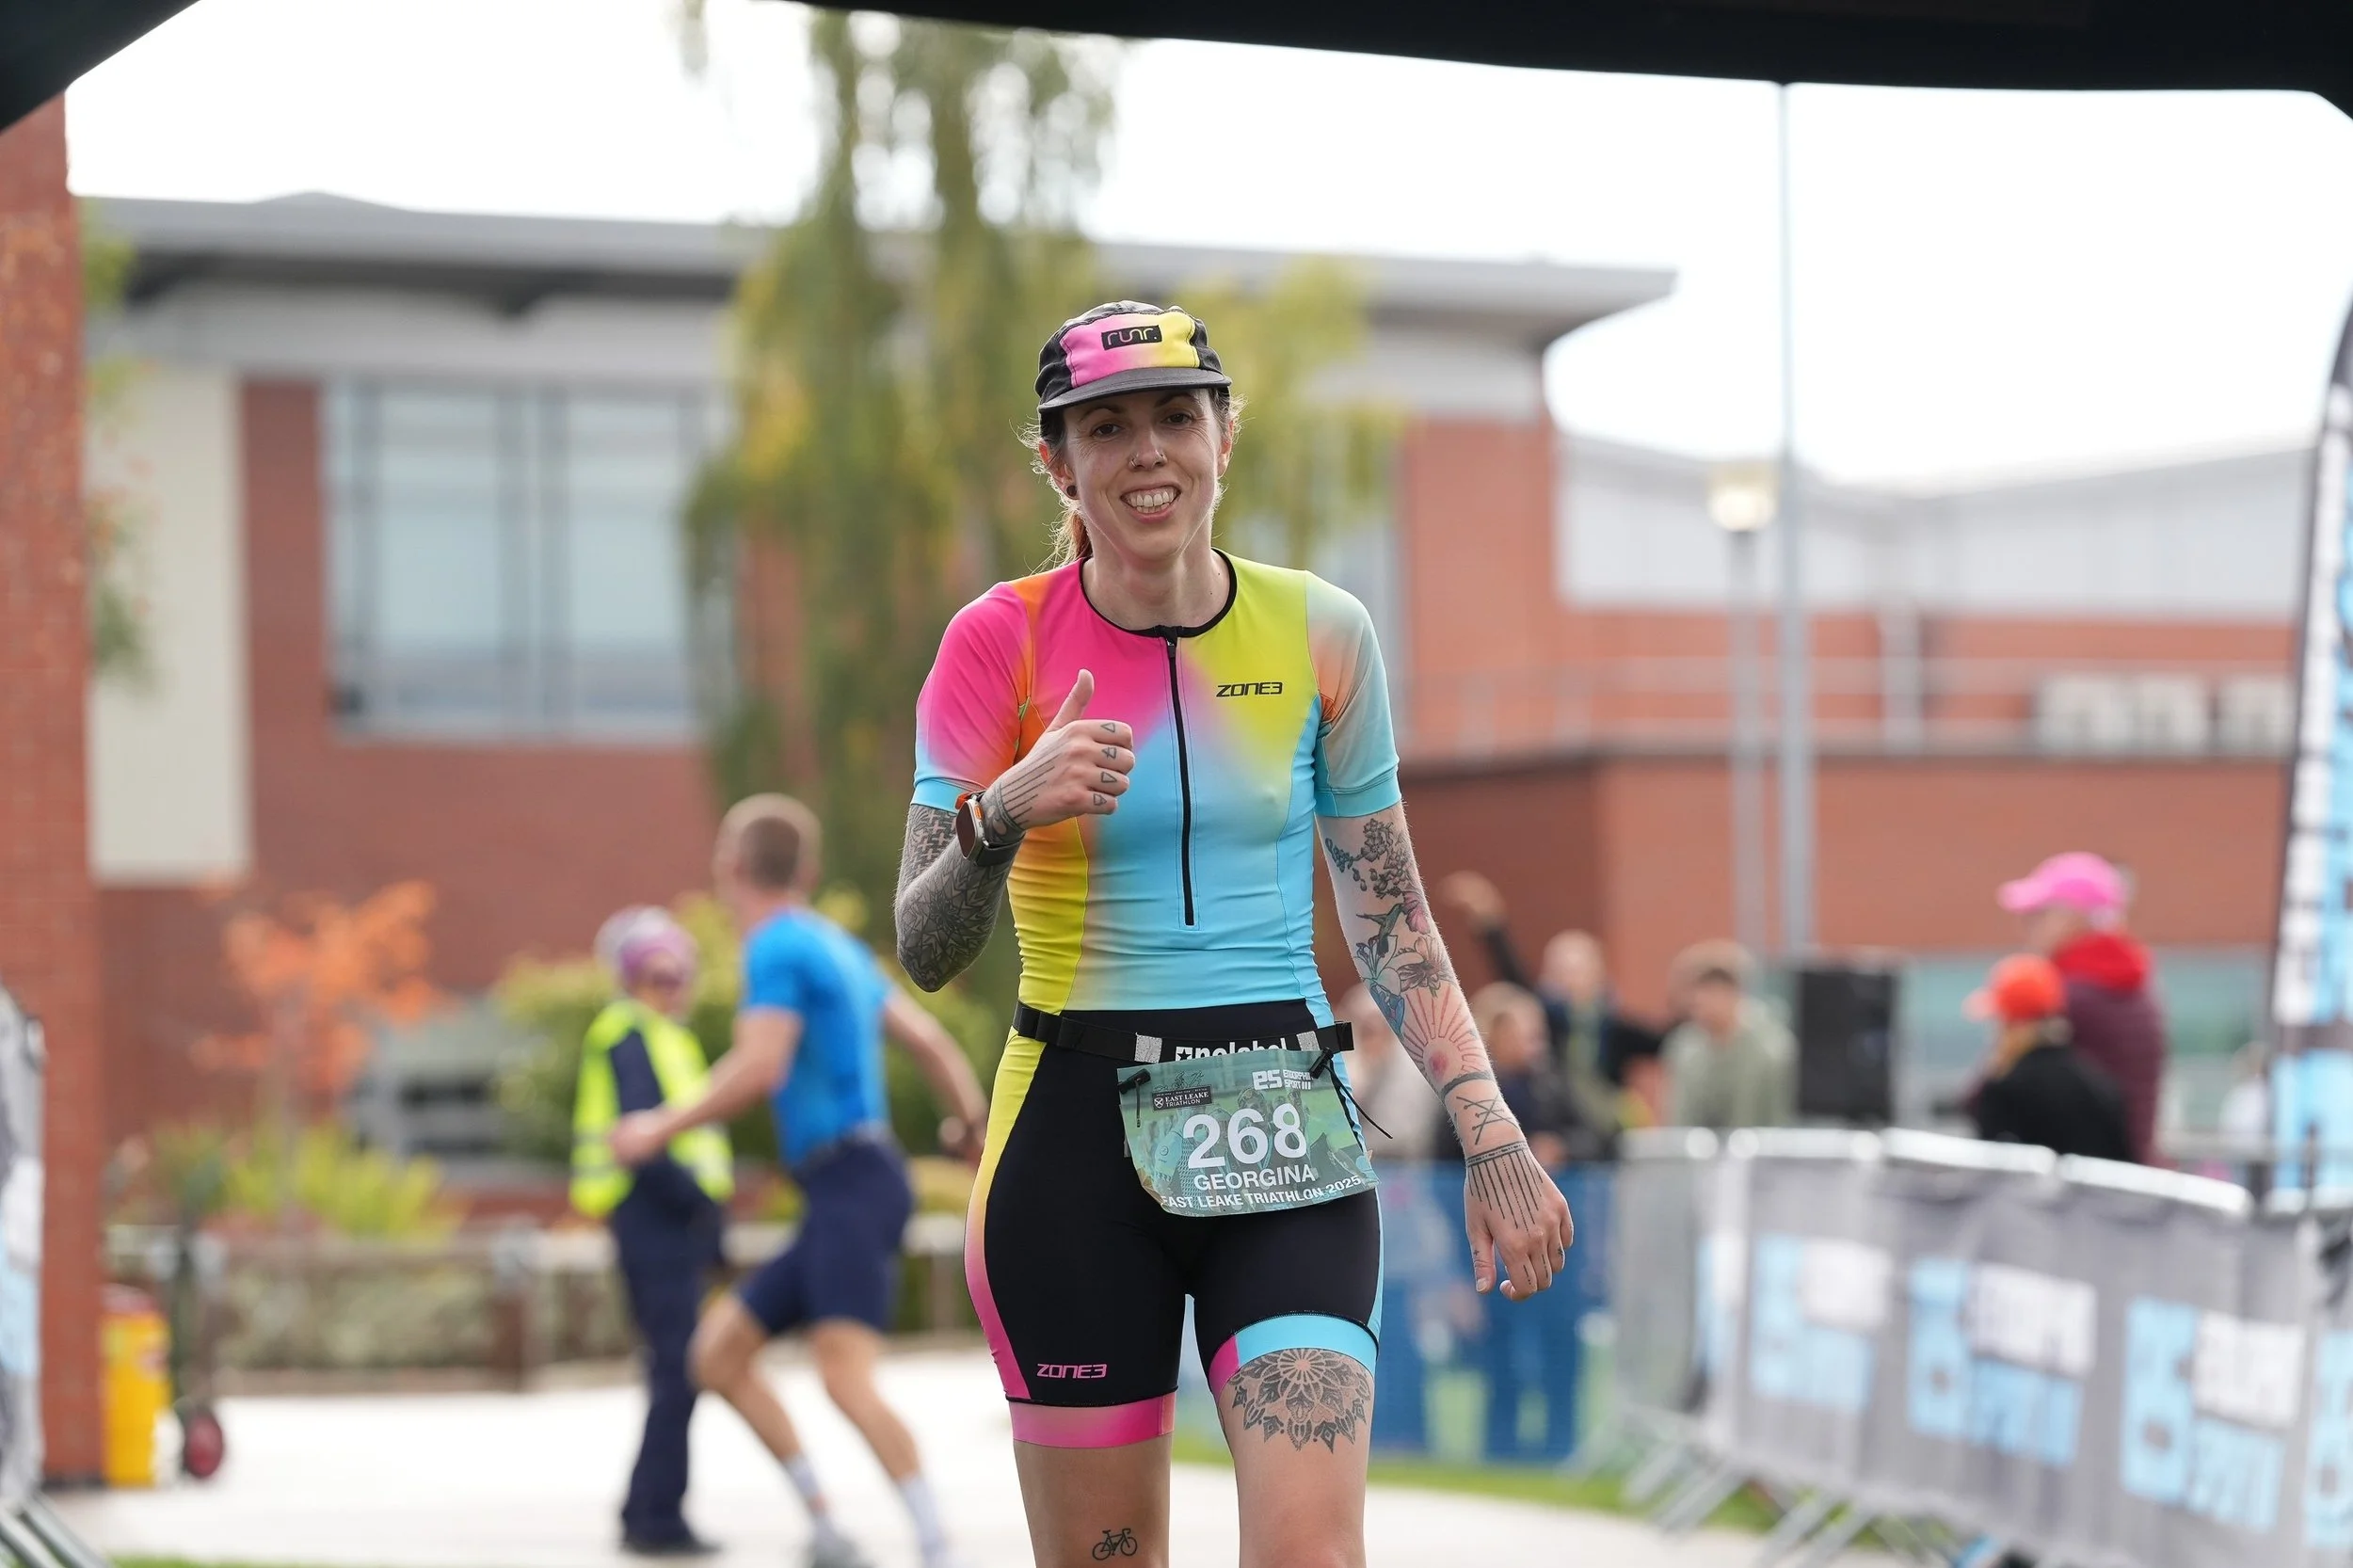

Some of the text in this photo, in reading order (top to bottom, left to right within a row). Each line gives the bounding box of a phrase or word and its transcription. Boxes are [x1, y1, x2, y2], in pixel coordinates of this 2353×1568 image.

[1216, 682, 1283, 697] ZONE3
[1166, 1098, 1201, 1107] TRIATHLON
[1184, 1092, 1209, 1100] LEAKE
[1182, 1103, 1307, 1169] 268
[1193, 1165, 1316, 1191] GEORGINA
[1197, 1193, 1243, 1208] LEAKE
[1244, 1187, 1325, 1204] TRIATHLON
[1326, 1176, 1362, 1193] 2025
[1036, 1363, 1108, 1379] ZONE3
